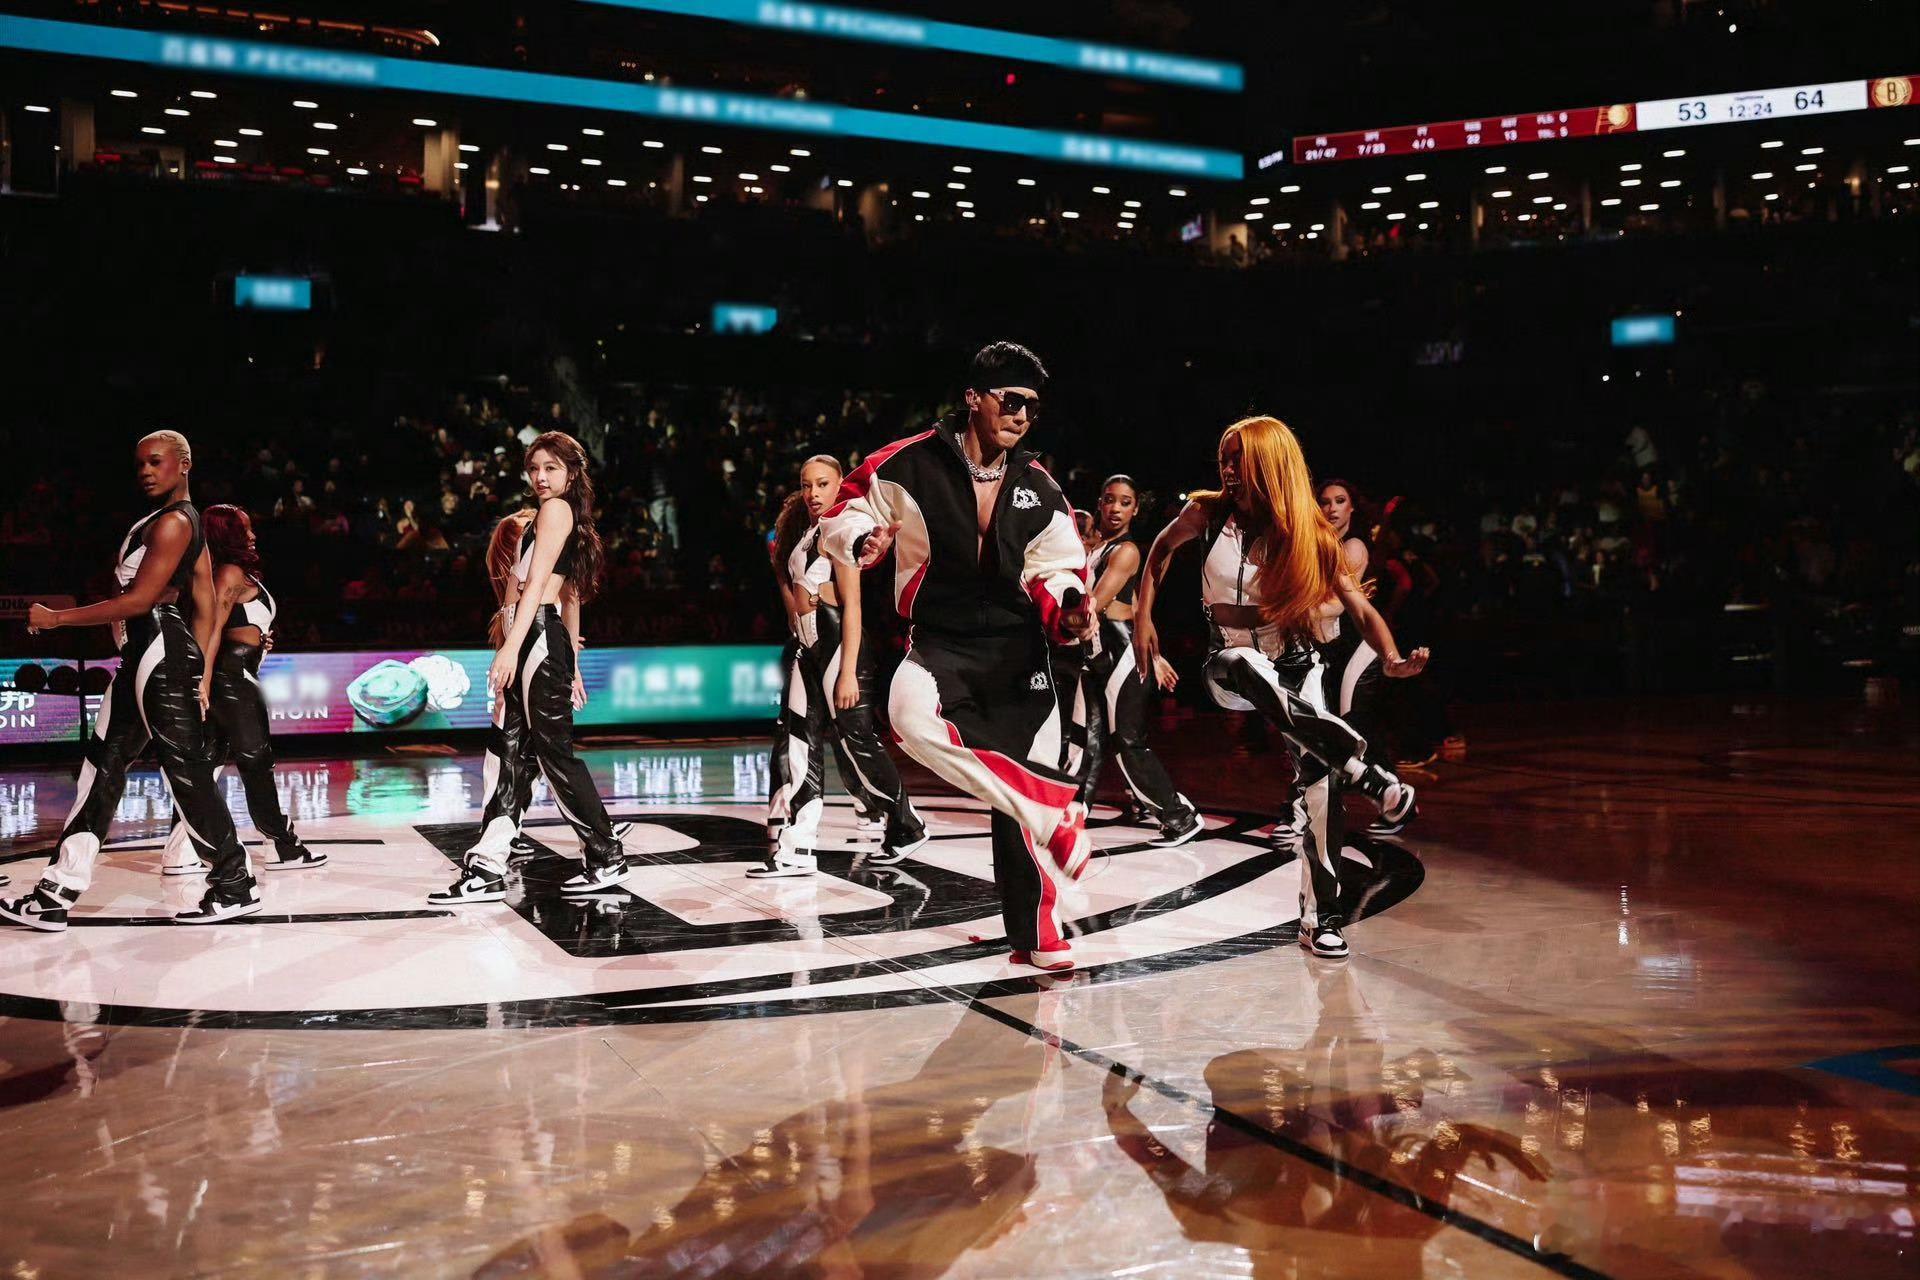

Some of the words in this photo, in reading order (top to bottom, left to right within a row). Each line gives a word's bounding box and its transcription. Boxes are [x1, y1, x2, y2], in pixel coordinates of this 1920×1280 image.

[1795, 89, 1825, 110] 64
[1887, 82, 1898, 102] B
[1678, 102, 1707, 121] 53
[1728, 102, 1773, 118] 12:24
